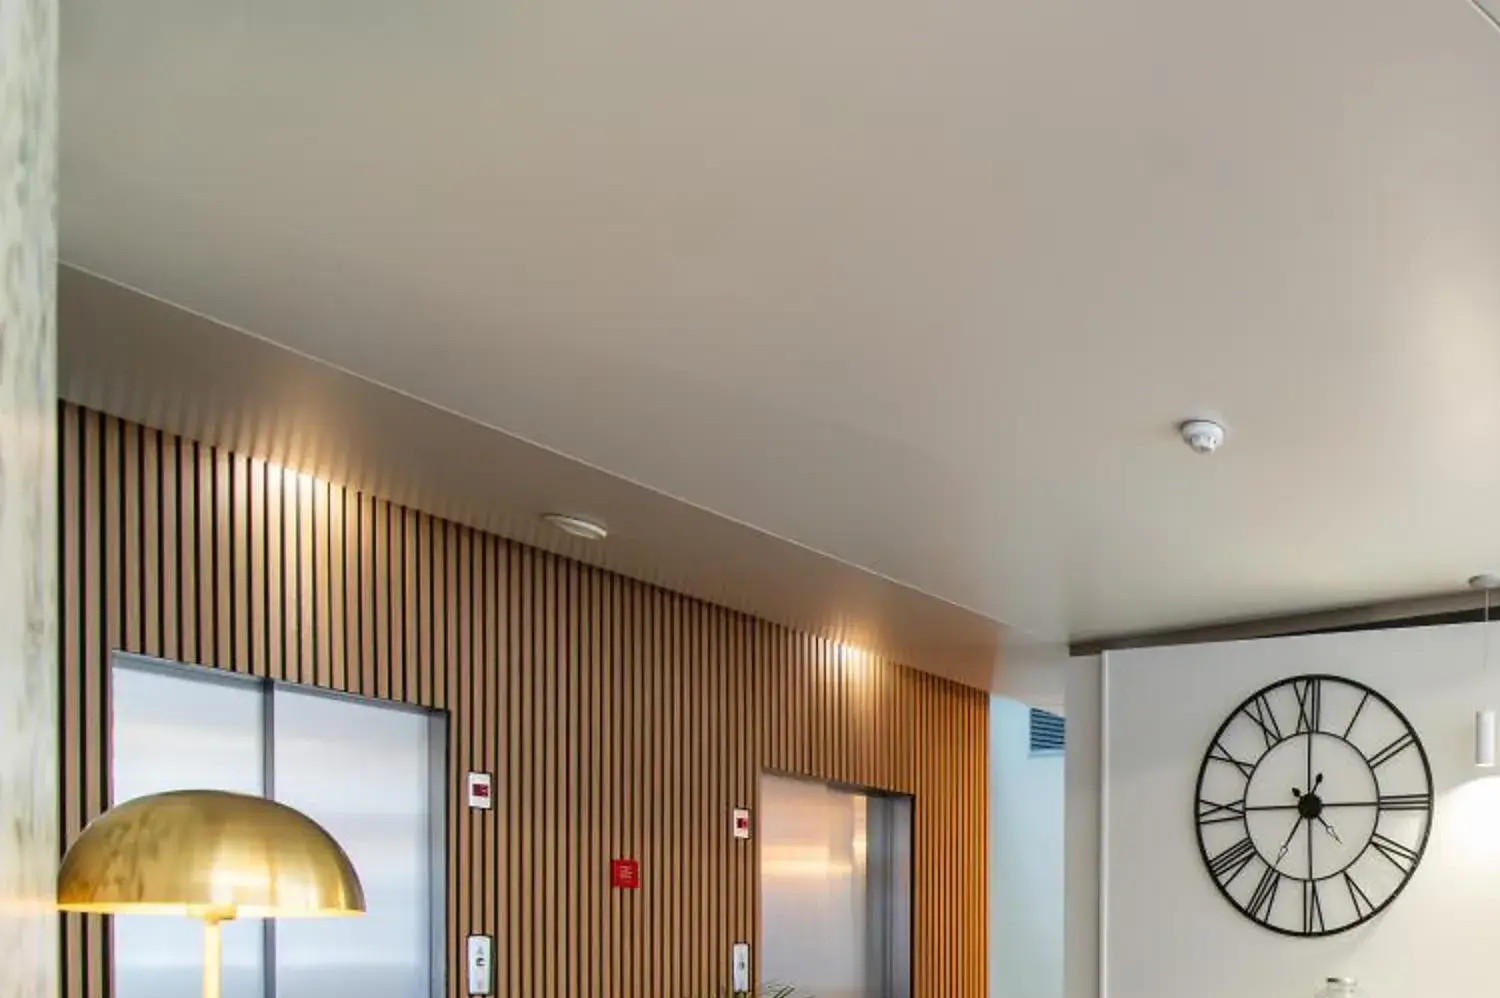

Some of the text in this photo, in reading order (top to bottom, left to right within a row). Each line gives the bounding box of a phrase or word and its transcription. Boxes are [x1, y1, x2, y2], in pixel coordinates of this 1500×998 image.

[1242, 694, 1282, 750] XI
[1293, 679, 1321, 733] XII
[1208, 742, 1255, 778] X
[1367, 732, 1416, 770] II
[1199, 799, 1245, 824] IX
[1378, 794, 1430, 810] III
[1208, 838, 1257, 887] VIII
[1369, 833, 1420, 875] IV
[1246, 866, 1281, 924] VII
[1302, 880, 1325, 934] VI
[1343, 870, 1376, 920] V
